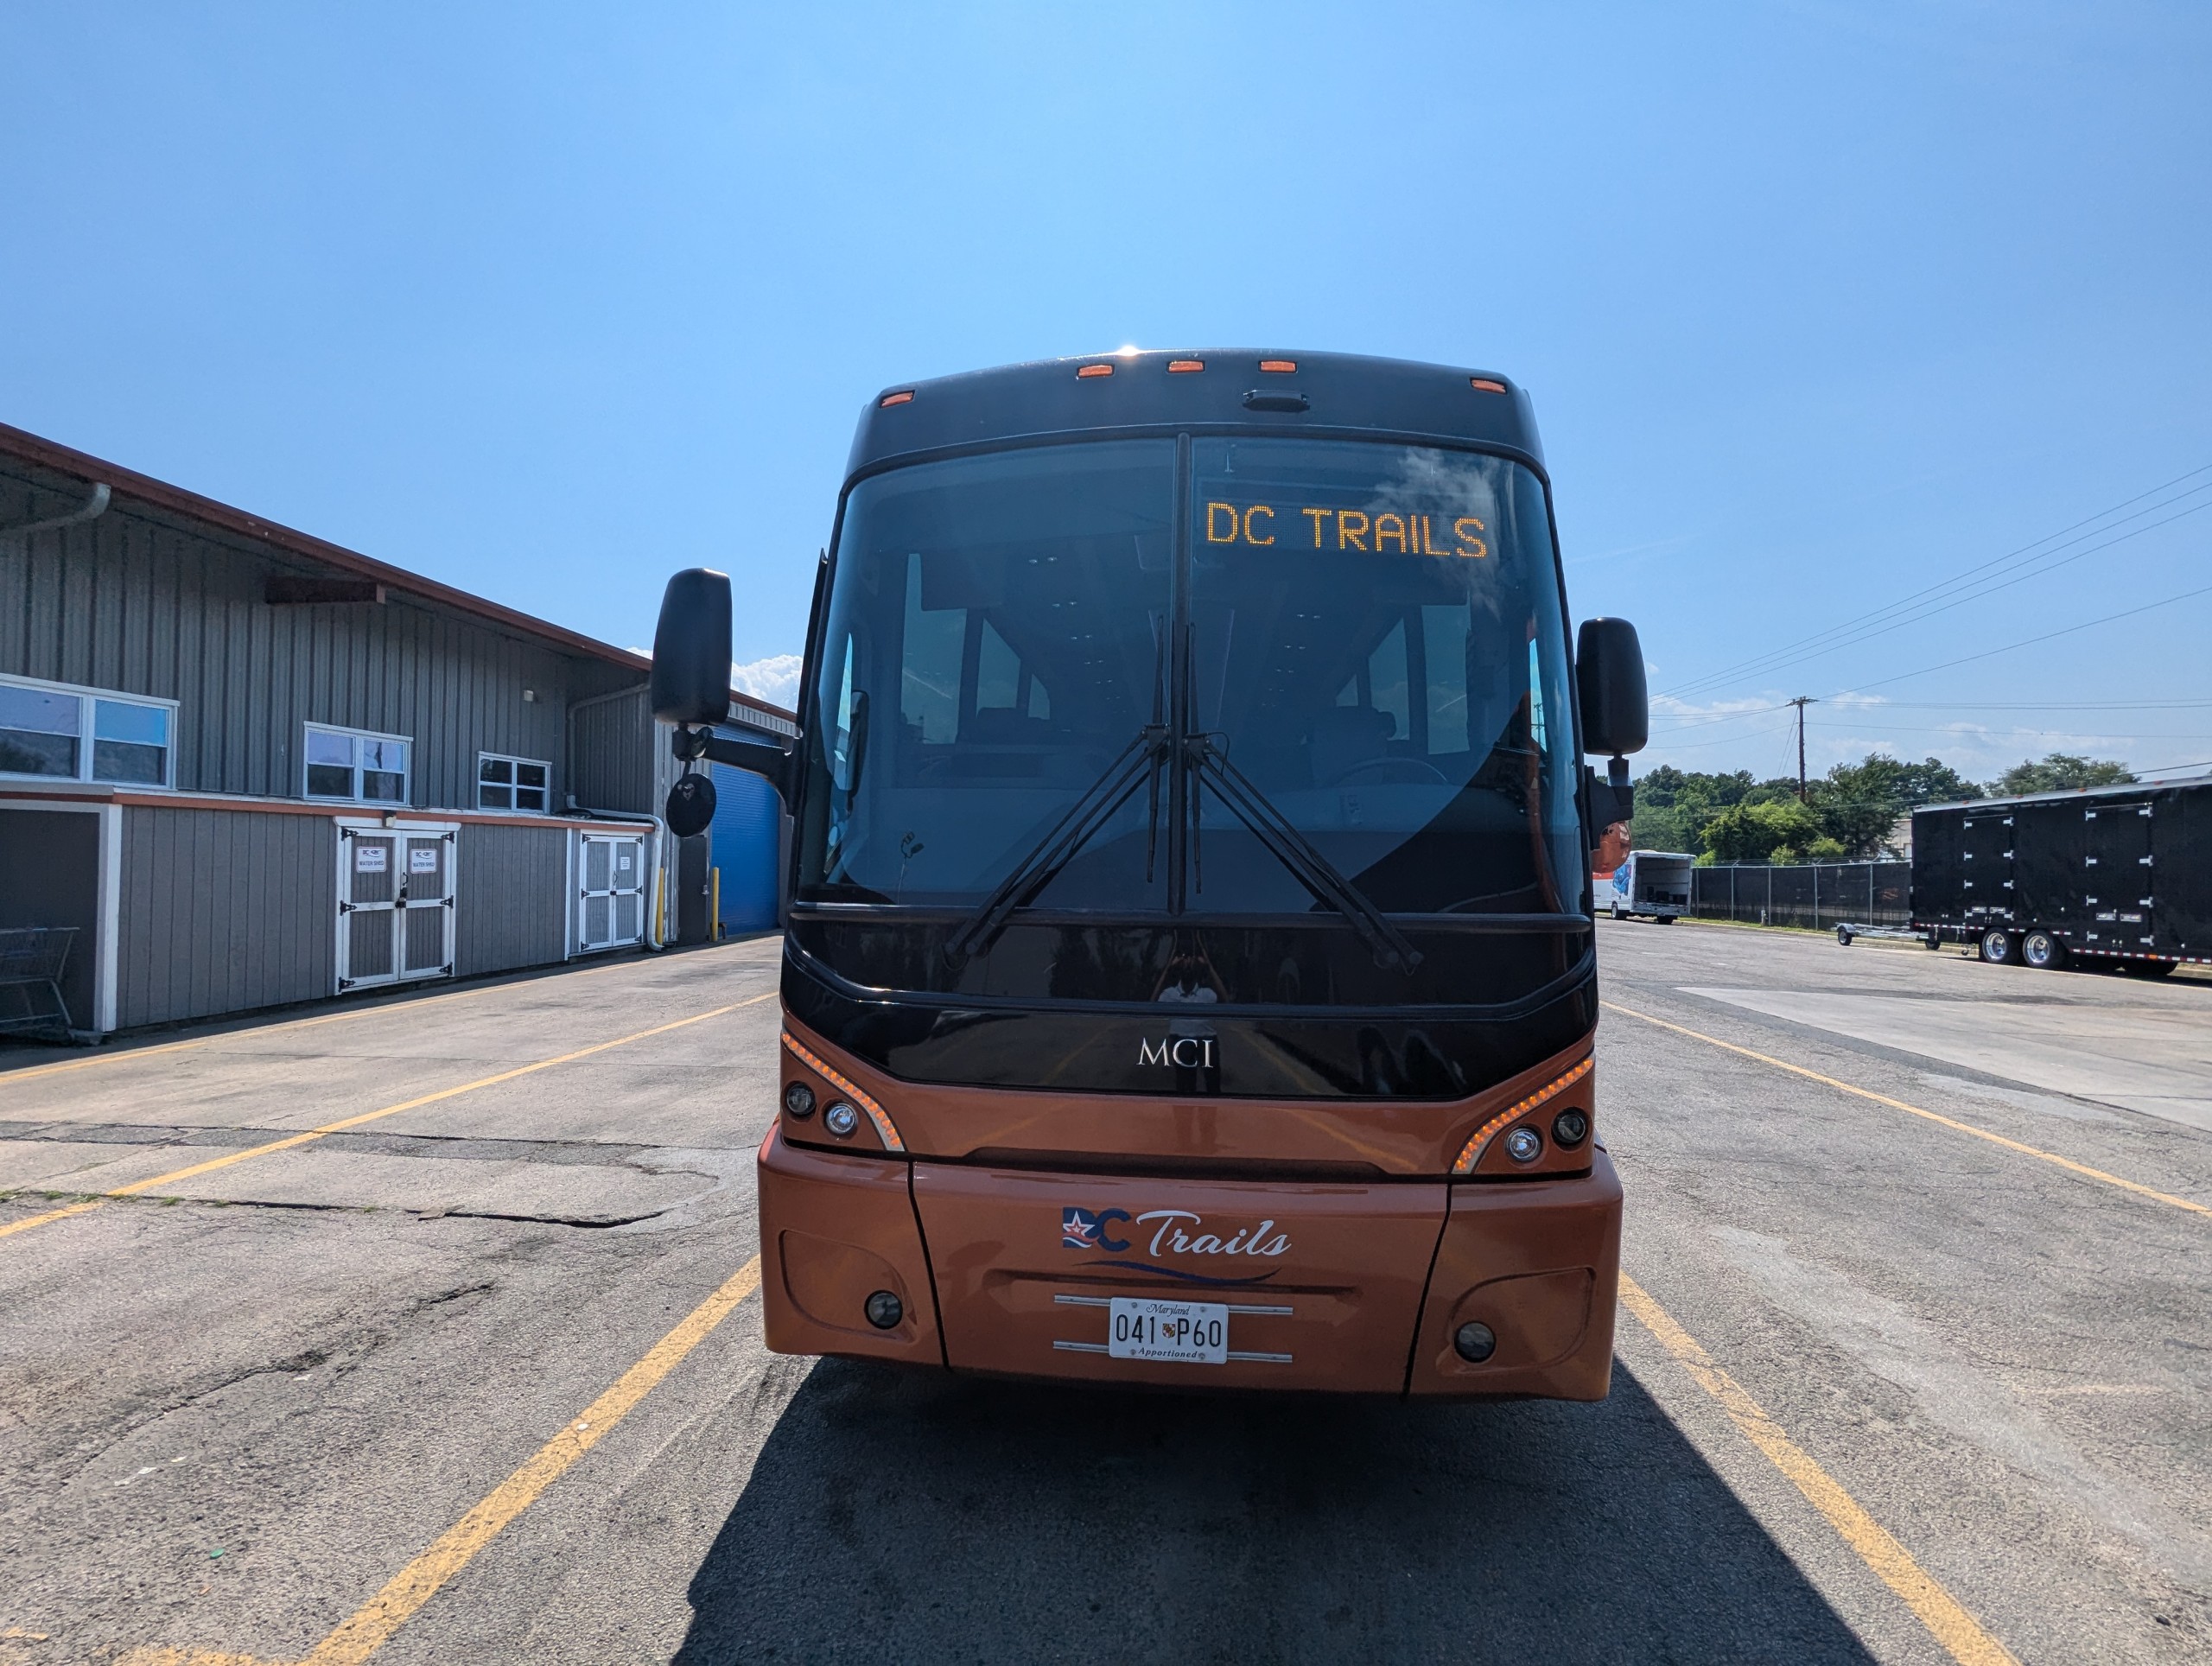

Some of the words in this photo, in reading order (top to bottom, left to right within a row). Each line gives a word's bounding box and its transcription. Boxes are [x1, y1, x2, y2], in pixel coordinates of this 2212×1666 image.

[1207, 502, 1274, 545] DC
[1302, 507, 1487, 558] TRAILS
[1136, 1037, 1214, 1068] MCI
[1063, 1206, 1131, 1252] DC
[1135, 1210, 1293, 1257] Trails
[1146, 1303, 1191, 1316] Maryland
[1116, 1313, 1155, 1344] 041
[1176, 1318, 1222, 1348] P60
[1138, 1346, 1198, 1359] Apportioned
